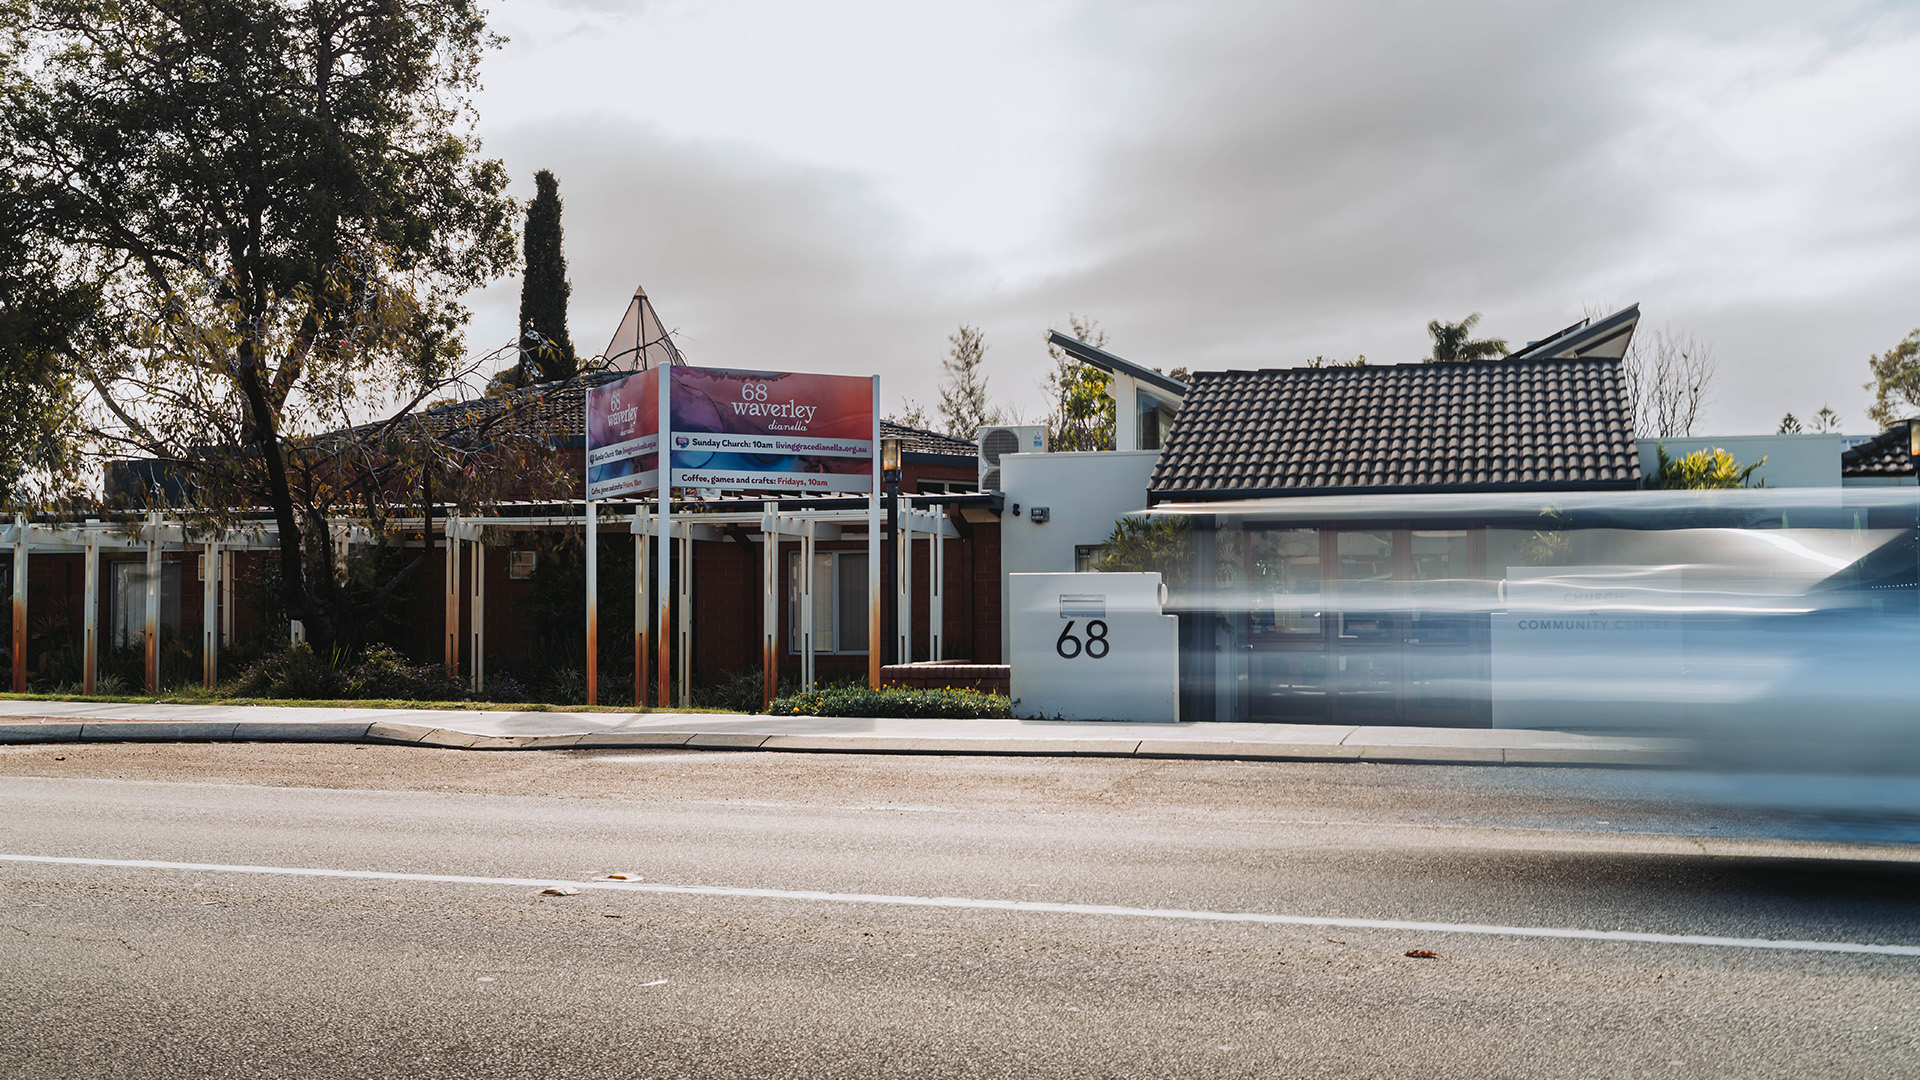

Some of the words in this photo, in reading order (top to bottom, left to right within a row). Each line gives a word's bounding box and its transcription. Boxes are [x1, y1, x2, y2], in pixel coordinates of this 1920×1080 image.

[741, 383, 768, 401] 68
[610, 393, 621, 412] 68
[607, 403, 639, 427] waverley
[731, 400, 817, 423] waverley
[768, 420, 809, 432] dianella
[692, 438, 721, 448] Sunday
[722, 439, 751, 448] Church:
[752, 441, 773, 449] 10am
[775, 442, 867, 453] livinggracedianella.org.au
[681, 474, 710, 484] Coffee,
[710, 476, 735, 485] games
[736, 475, 750, 484] and
[751, 476, 776, 485] crafts:
[777, 477, 807, 487] Fridays,
[808, 478, 828, 486] 10am
[1564, 592, 1625, 603] CHURCH
[1518, 620, 1608, 630] COMMUNITY
[1056, 620, 1110, 659] 68
